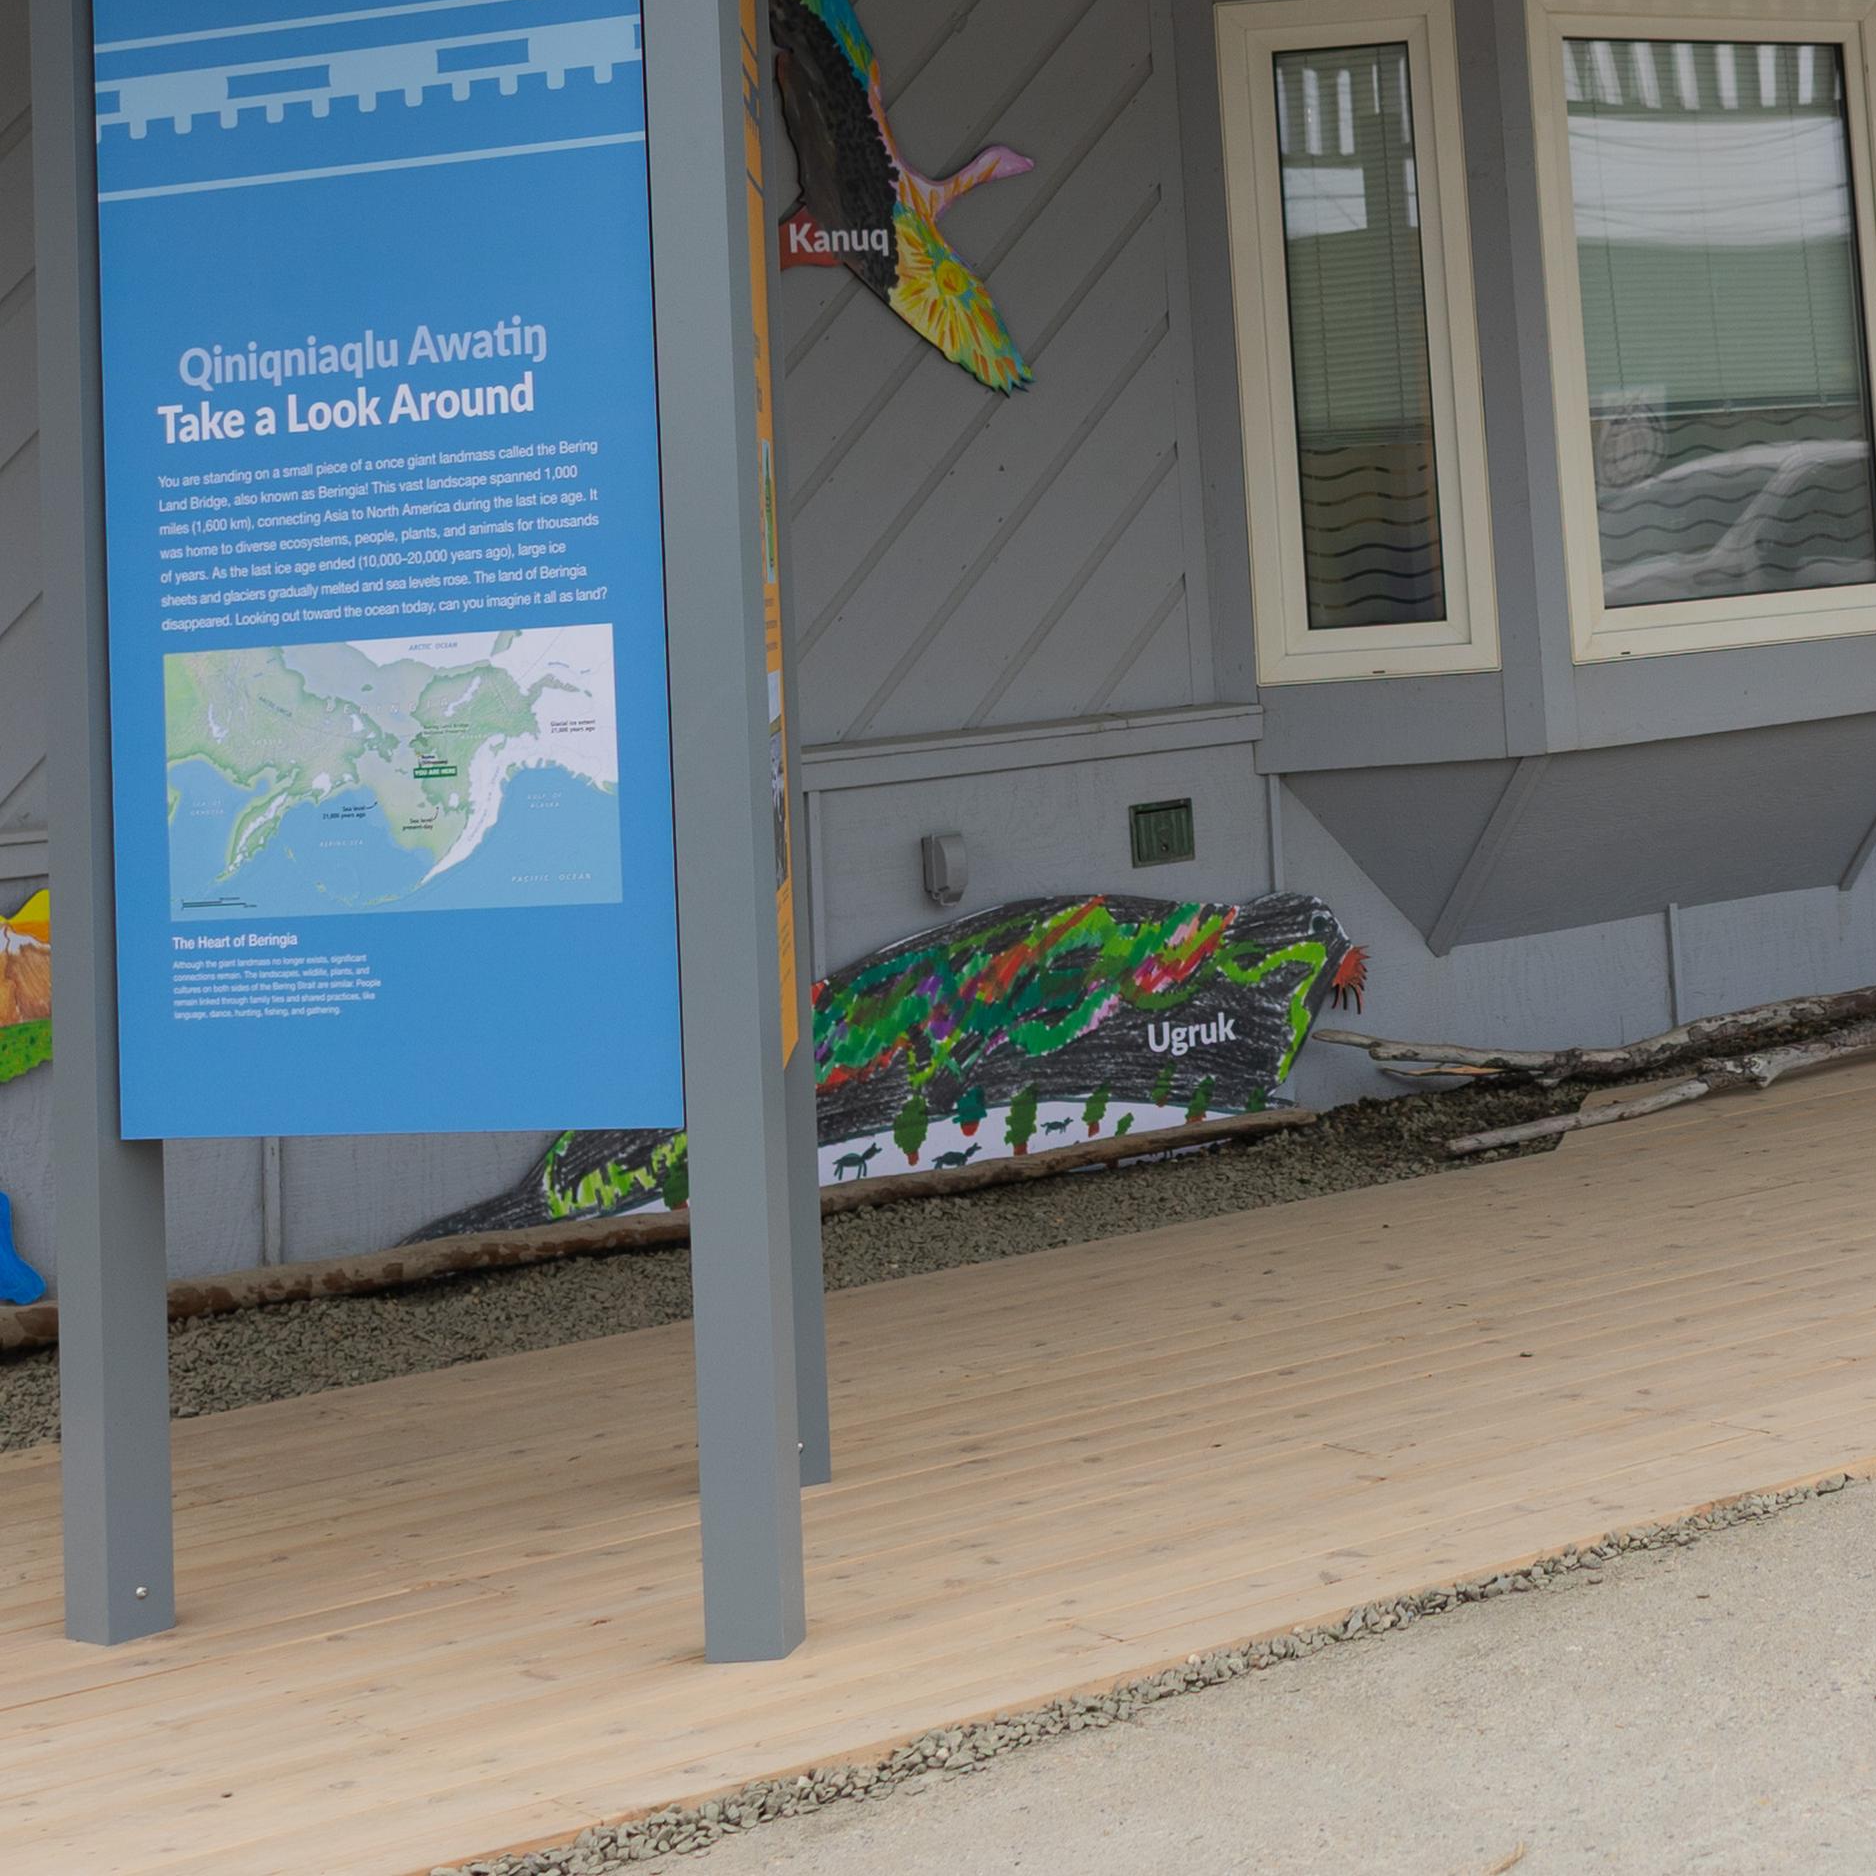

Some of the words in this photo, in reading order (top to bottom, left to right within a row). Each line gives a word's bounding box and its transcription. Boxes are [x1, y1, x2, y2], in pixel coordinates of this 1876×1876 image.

[789, 222, 889, 257] Kanuq
[179, 329, 399, 391] Qiniqniaqlu
[157, 401, 245, 444] Take
[254, 405, 276, 437] a
[287, 386, 382, 433] Look
[388, 370, 534, 424] Around
[159, 475, 179, 487] You
[182, 475, 200, 486] are
[202, 470, 252, 485] standing
[254, 469, 269, 480] on
[272, 468, 280, 478] a
[282, 463, 313, 477] small
[315, 461, 347, 477] piece
[350, 458, 362, 471] of
[365, 460, 373, 470] a
[375, 457, 404, 469] once
[406, 453, 436, 470] giant
[438, 449, 495, 464] landmass
[498, 444, 534, 459] called
[535, 443, 556, 455] the
[558, 439, 598, 454] Bering
[158, 498, 187, 512] Land
[189, 496, 230, 510] Bridge,
[234, 493, 257, 505] also
[260, 491, 298, 503] known
[301, 489, 315, 500] as
[317, 482, 368, 499] Beringia!
[373, 480, 396, 493] This
[399, 478, 423, 491] vast
[425, 475, 487, 490] landscape
[489, 467, 541, 486] spanned
[545, 464, 578, 480] 1,000
[159, 522, 189, 534] miles
[191, 518, 227, 535] (1,600
[229, 516, 253, 530] km),
[257, 511, 321, 528] connecting
[323, 509, 348, 522] Asia
[351, 508, 364, 520] to
[366, 504, 399, 518] North
[402, 501, 450, 515] America
[452, 498, 491, 513] during
[493, 495, 513, 508] the
[515, 493, 536, 506] last
[539, 492, 558, 505] ice
[560, 491, 585, 505] age.
[589, 488, 597, 500] It
[160, 548, 183, 559] was
[185, 545, 218, 556] home
[220, 543, 232, 555] to
[235, 540, 276, 553] diverse
[279, 535, 350, 550] ecosystems,
[354, 529, 397, 546] people,
[401, 527, 439, 543] plants,
[443, 523, 466, 537] and
[468, 519, 514, 535] animals
[516, 518, 533, 531] for
[536, 513, 599, 529] thousands
[160, 570, 172, 583] of
[175, 570, 208, 584] years.
[212, 566, 227, 579] As
[229, 565, 248, 577] the
[250, 563, 271, 576] last
[274, 562, 291, 574] ice
[294, 562, 316, 575] age
[318, 556, 355, 571] ended
[450, 549, 482, 564] years
[485, 544, 516, 561] ago),
[517, 543, 546, 558] large
[548, 541, 566, 553] ice
[161, 594, 197, 607] sheets
[199, 590, 221, 604] and
[223, 588, 266, 605] glaciers
[267, 583, 318, 602] gradually
[320, 580, 359, 594] melted
[361, 578, 384, 592] and
[385, 579, 407, 590] sea
[408, 574, 441, 588] levels
[442, 574, 470, 586] rose.
[475, 570, 496, 583] The
[497, 568, 523, 581] land
[525, 566, 537, 580] of
[539, 564, 587, 580] Beringia
[161, 614, 232, 631] disappeared.
[235, 611, 279, 626] Looking
[281, 609, 300, 622] out
[302, 606, 342, 620] toward
[343, 605, 362, 617] the
[364, 604, 399, 616] ocean
[401, 600, 437, 614] today,
[438, 599, 460, 611] can
[462, 598, 484, 612] you
[485, 593, 531, 609] imagine
[533, 591, 541, 603] it
[543, 590, 557, 603] all
[559, 591, 574, 602] as
[575, 586, 607, 601] land?
[174, 936, 194, 949] The
[197, 935, 230, 948] Heart
[233, 934, 245, 947] of
[248, 933, 297, 948] Beringia
[1148, 1012, 1236, 1057] Ugruk
